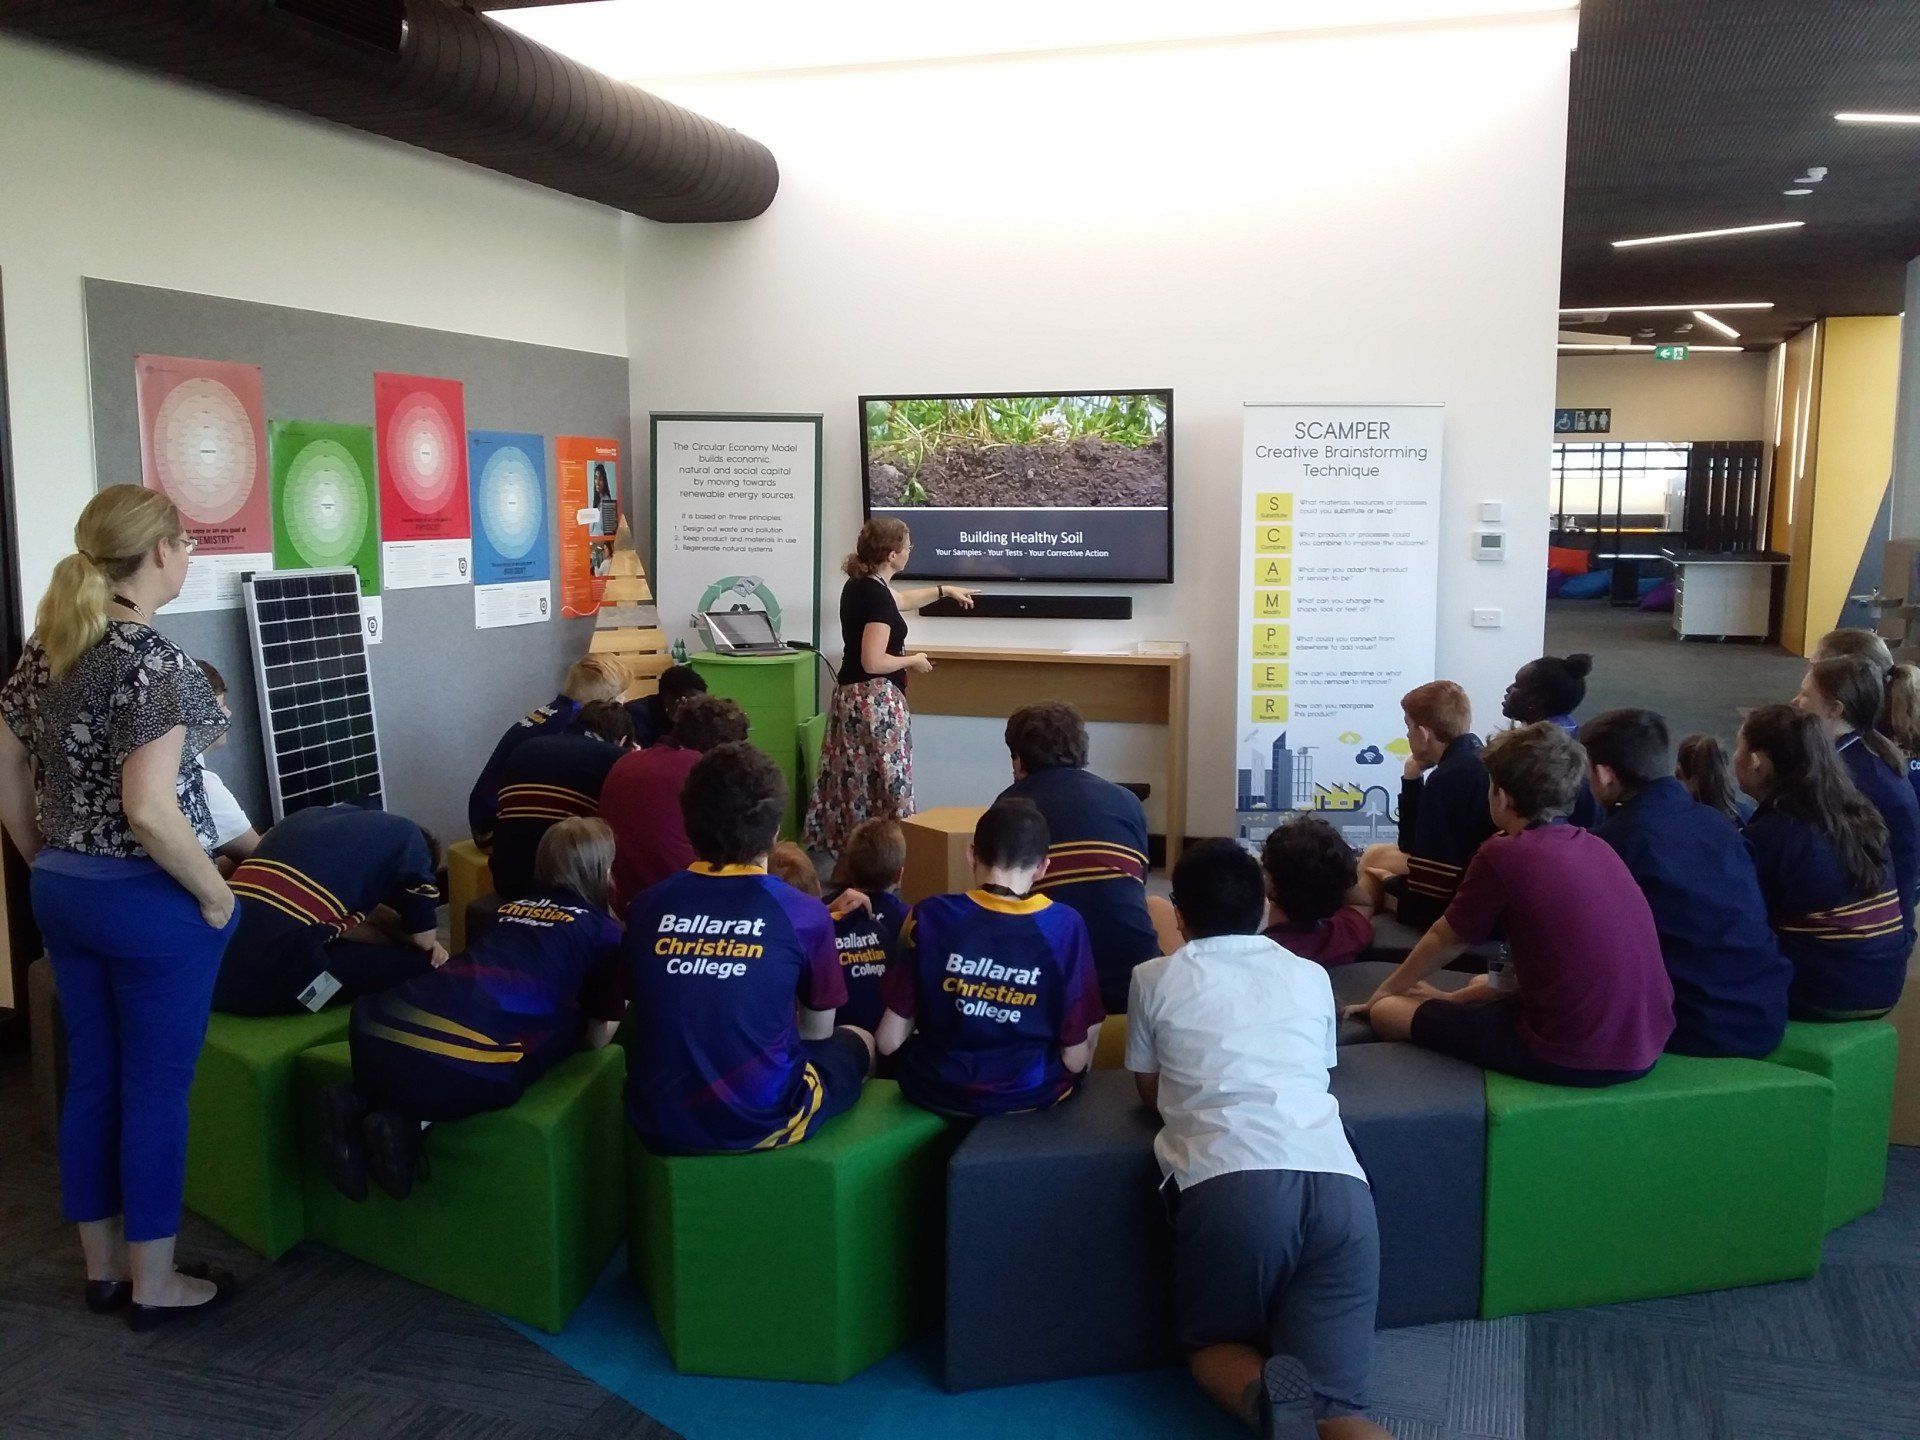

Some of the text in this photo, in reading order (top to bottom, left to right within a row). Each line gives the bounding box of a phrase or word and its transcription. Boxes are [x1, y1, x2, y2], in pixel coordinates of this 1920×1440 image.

[1295, 422, 1390, 439] SCAMPER
[674, 442, 797, 452] The Circular Economy Model
[1256, 445, 1427, 461] Creative Brainstorming
[761, 468, 791, 476] capital
[1303, 464, 1380, 479] Technique
[708, 479, 739, 487] moving
[680, 490, 724, 498] renewable
[728, 491, 758, 500] energy
[1270, 497, 1279, 510] S
[683, 525, 704, 533] Design
[1267, 528, 1280, 542] C
[193, 535, 234, 545] EMISTRY?
[960, 532, 1083, 545] Building Healthy Soil
[683, 544, 720, 552] Regenerate
[953, 549, 982, 557] Samples
[1268, 562, 1278, 575] A
[1266, 594, 1278, 607] M
[1268, 628, 1276, 641] P
[1267, 667, 1275, 680] E
[1266, 699, 1274, 712] R
[497, 904, 574, 922] Christian
[657, 914, 765, 936] Ballarat
[834, 932, 879, 949] Ballarat
[654, 938, 764, 958] Christian
[839, 949, 886, 966] Christian
[667, 958, 747, 979] College
[851, 963, 886, 977] College
[946, 953, 1041, 985] Ballarat
[942, 977, 1037, 1006] Christian
[955, 998, 1021, 1023] College
